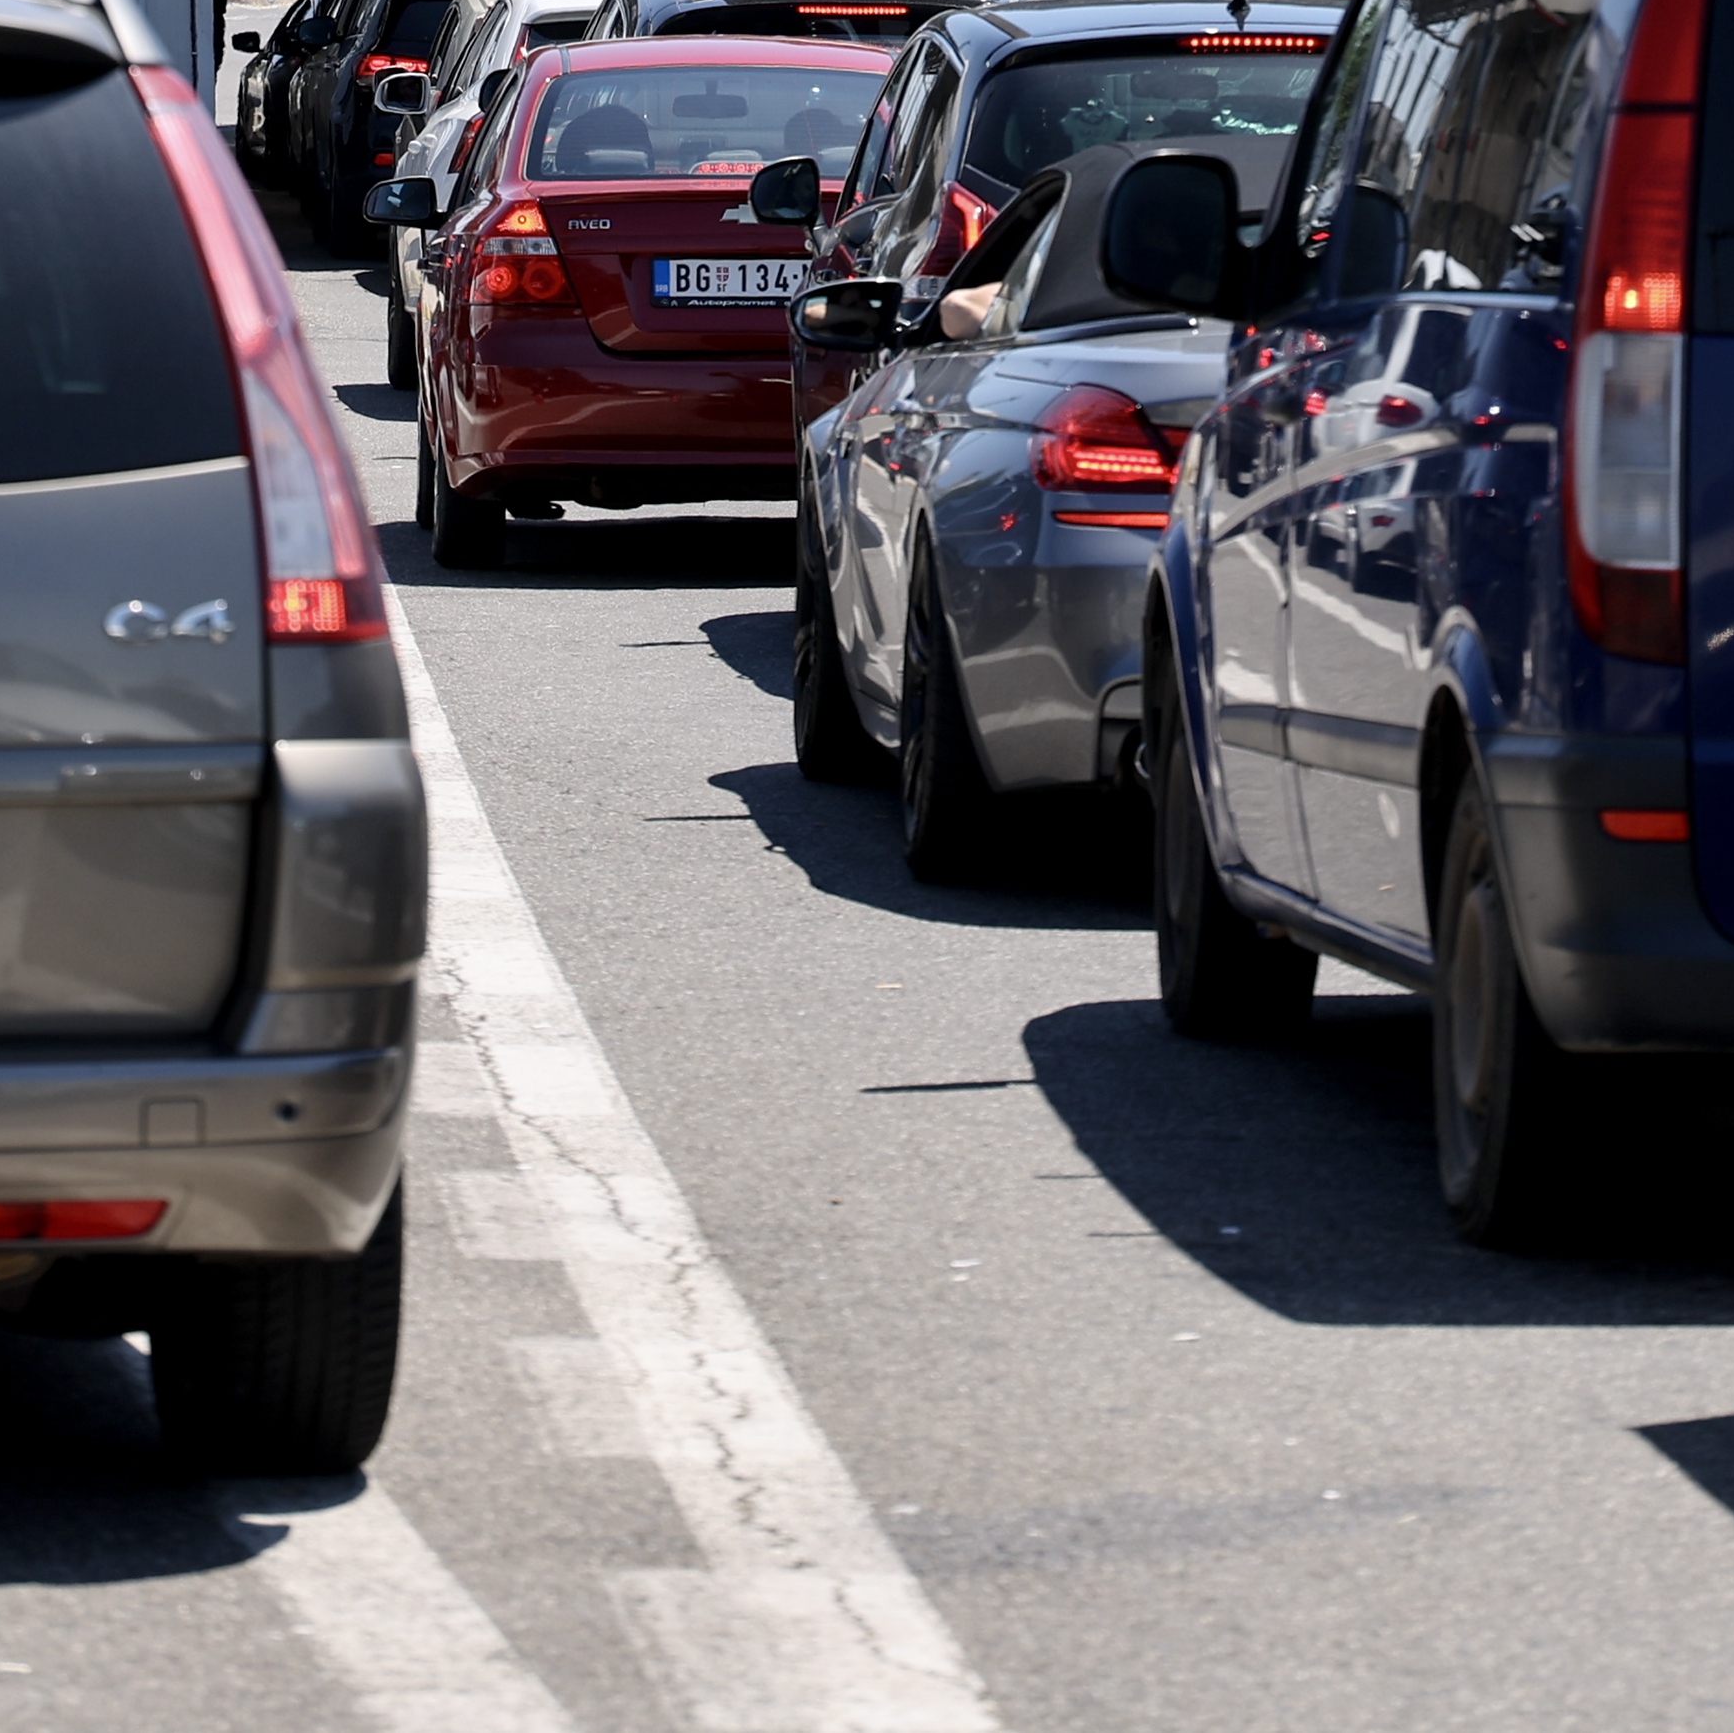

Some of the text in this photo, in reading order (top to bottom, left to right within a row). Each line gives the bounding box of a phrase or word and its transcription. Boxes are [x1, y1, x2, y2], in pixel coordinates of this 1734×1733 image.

[568, 218, 611, 230] AVEO
[676, 264, 711, 293] BG
[687, 299, 777, 307] Autopromet
[103, 597, 236, 645] C4
